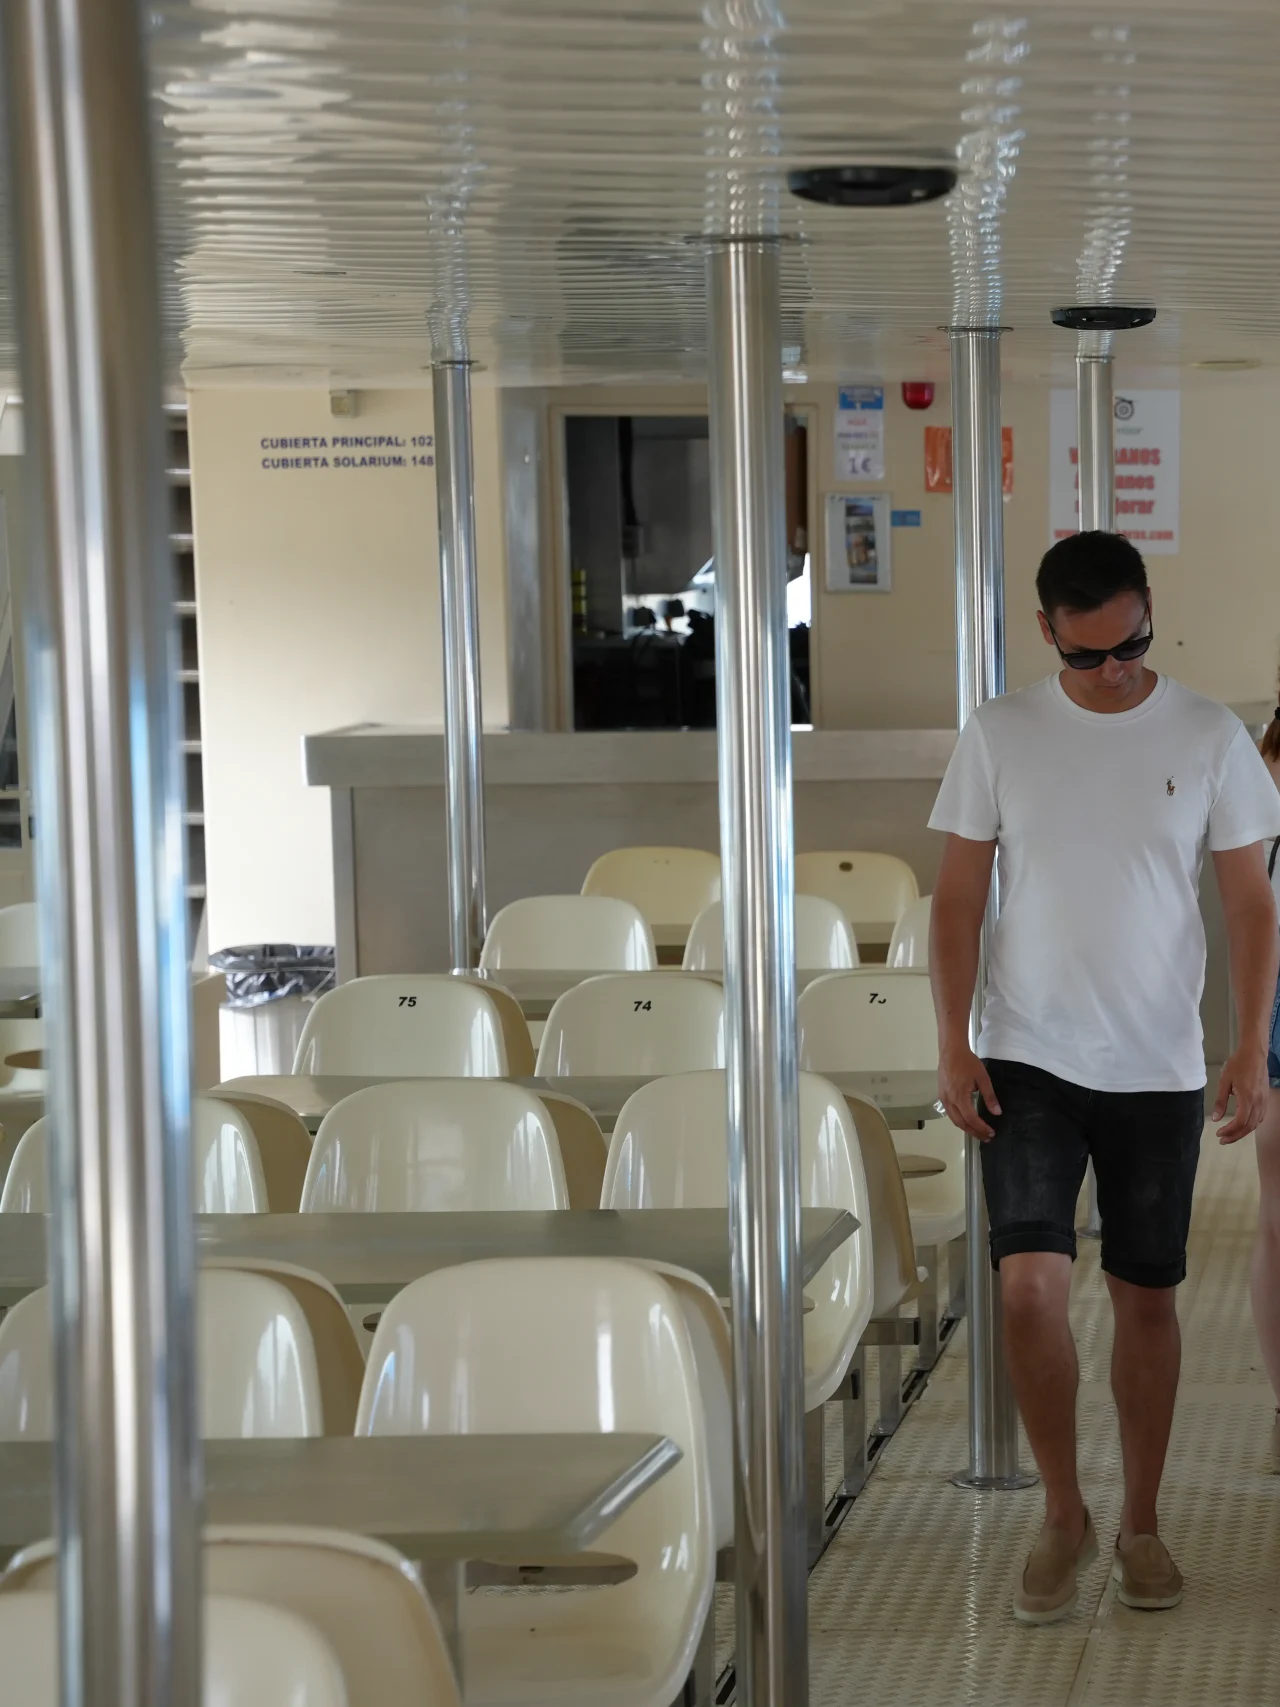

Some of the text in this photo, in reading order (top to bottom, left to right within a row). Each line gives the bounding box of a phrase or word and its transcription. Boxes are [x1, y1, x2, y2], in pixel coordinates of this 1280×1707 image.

[260, 435, 433, 450] CUBIERTA PRINCIPAL: 102
[261, 455, 434, 469] CUBIERTA SOLARIUM: 148
[398, 996, 417, 1008] 75
[633, 1000, 652, 1012] 74
